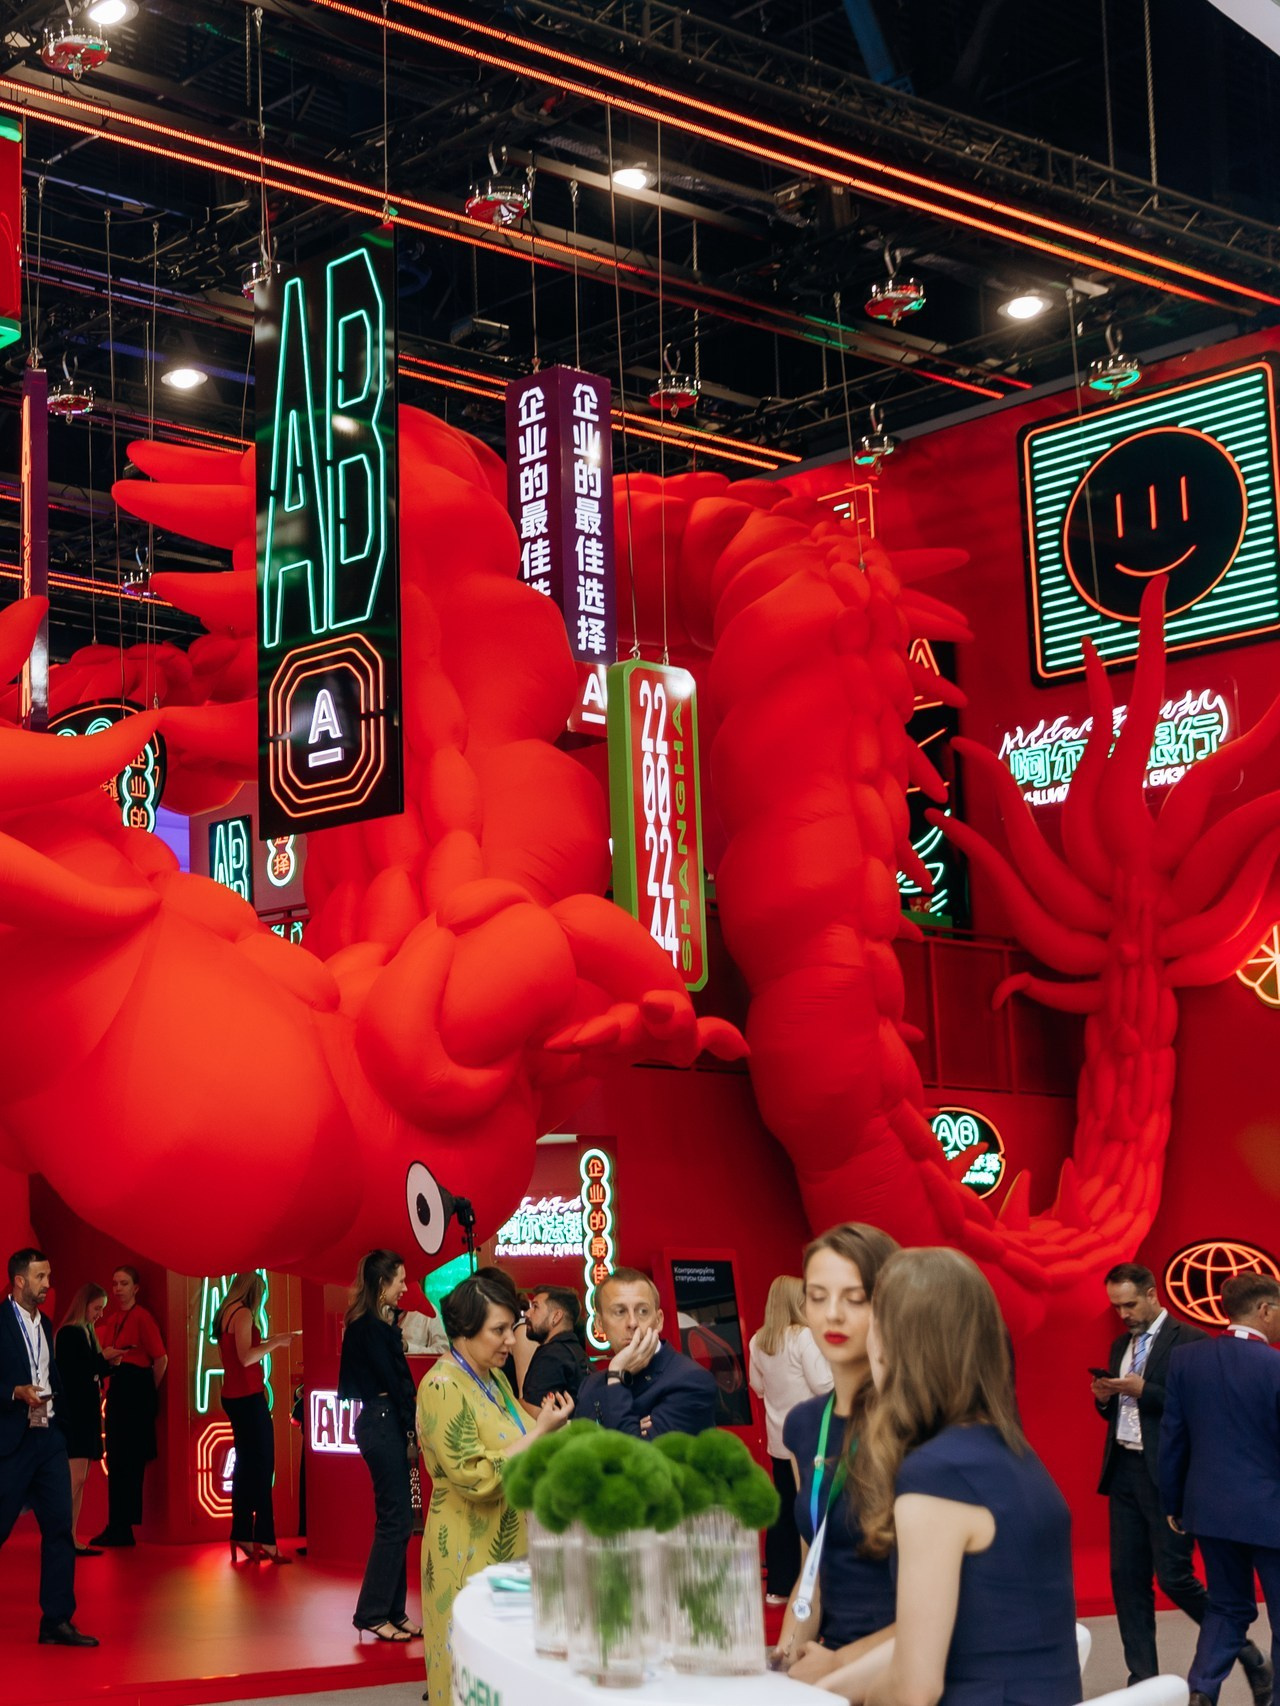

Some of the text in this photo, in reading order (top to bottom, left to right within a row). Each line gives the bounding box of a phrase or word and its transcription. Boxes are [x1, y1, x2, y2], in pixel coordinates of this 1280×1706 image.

[264, 247, 384, 648] AB
[572, 383, 607, 655] 企业的最佳选择
[308, 688, 343, 745] A
[582, 671, 606, 708] A
[671, 700, 693, 973] SHANGHA
[587, 1158, 609, 1341] 企业的最佳
